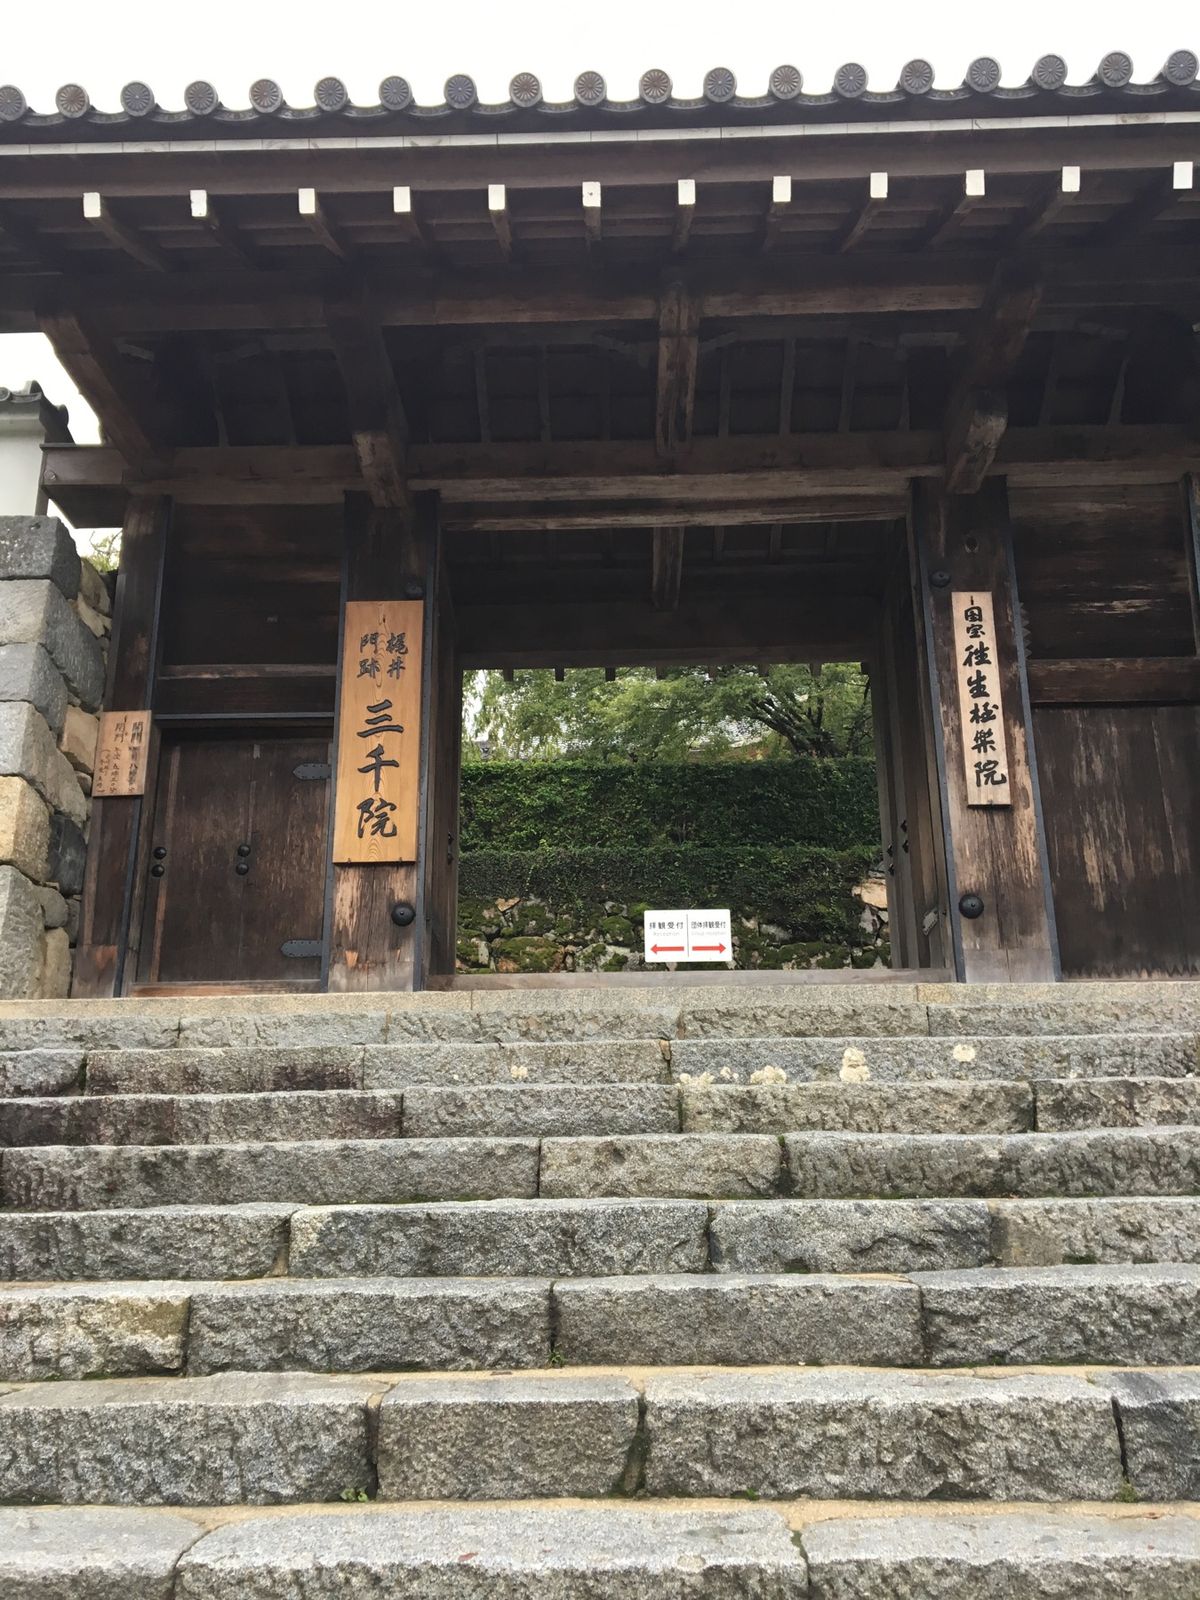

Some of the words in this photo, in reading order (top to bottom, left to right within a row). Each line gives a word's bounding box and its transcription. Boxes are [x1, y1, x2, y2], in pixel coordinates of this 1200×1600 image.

[356, 631, 381, 680] 門跡
[356, 698, 405, 840] 三千院
[649, 921, 684, 930] 拝観受付
[691, 921, 727, 930] 団体拝観受付
